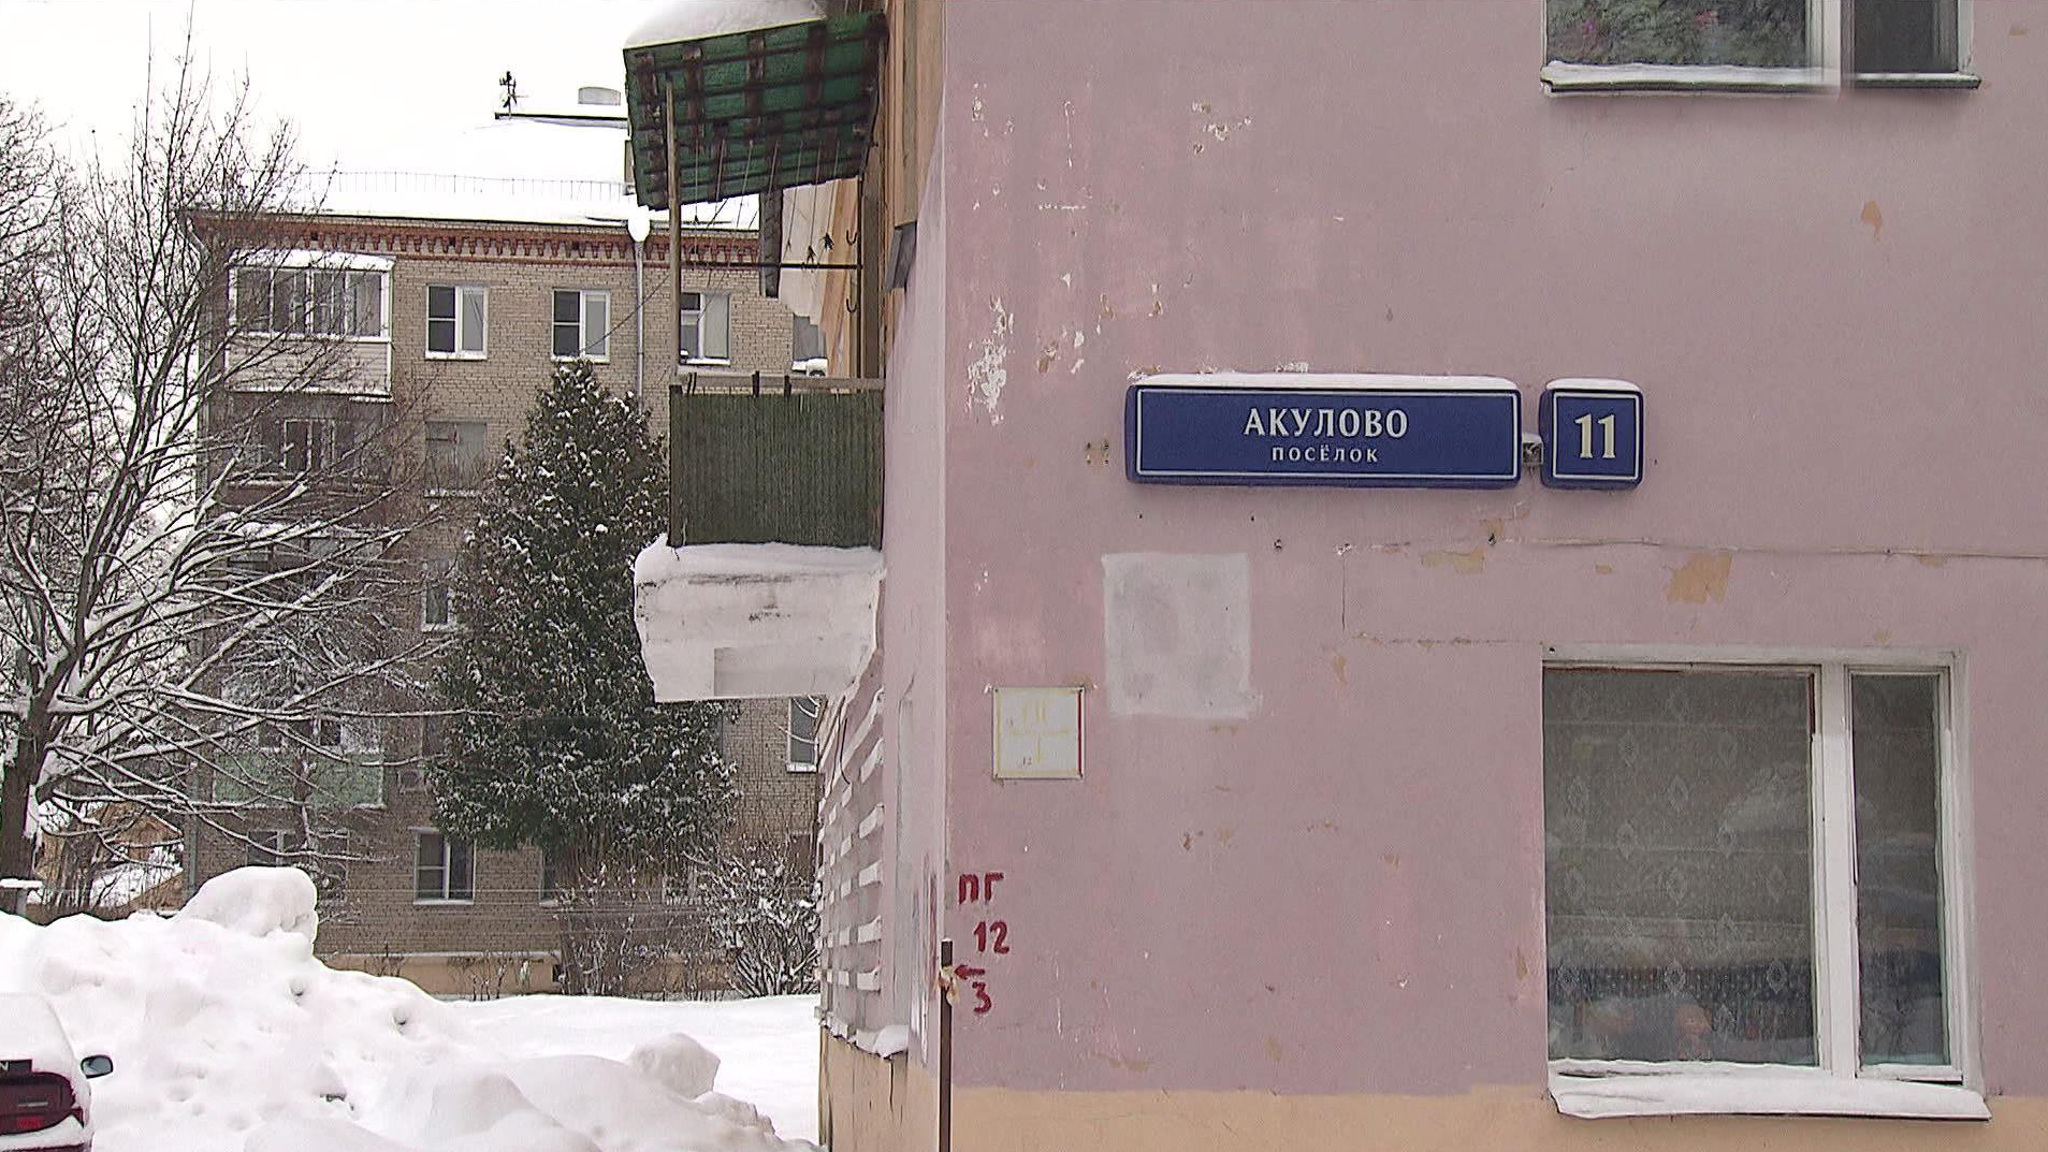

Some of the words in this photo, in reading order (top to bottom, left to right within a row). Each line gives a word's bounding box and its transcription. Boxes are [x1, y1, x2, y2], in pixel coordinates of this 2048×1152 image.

[1243, 408, 1409, 438] АКУЛОВО
[1574, 413, 1616, 458] 11
[973, 920, 1010, 954] 12
[972, 981, 992, 1014] 3
